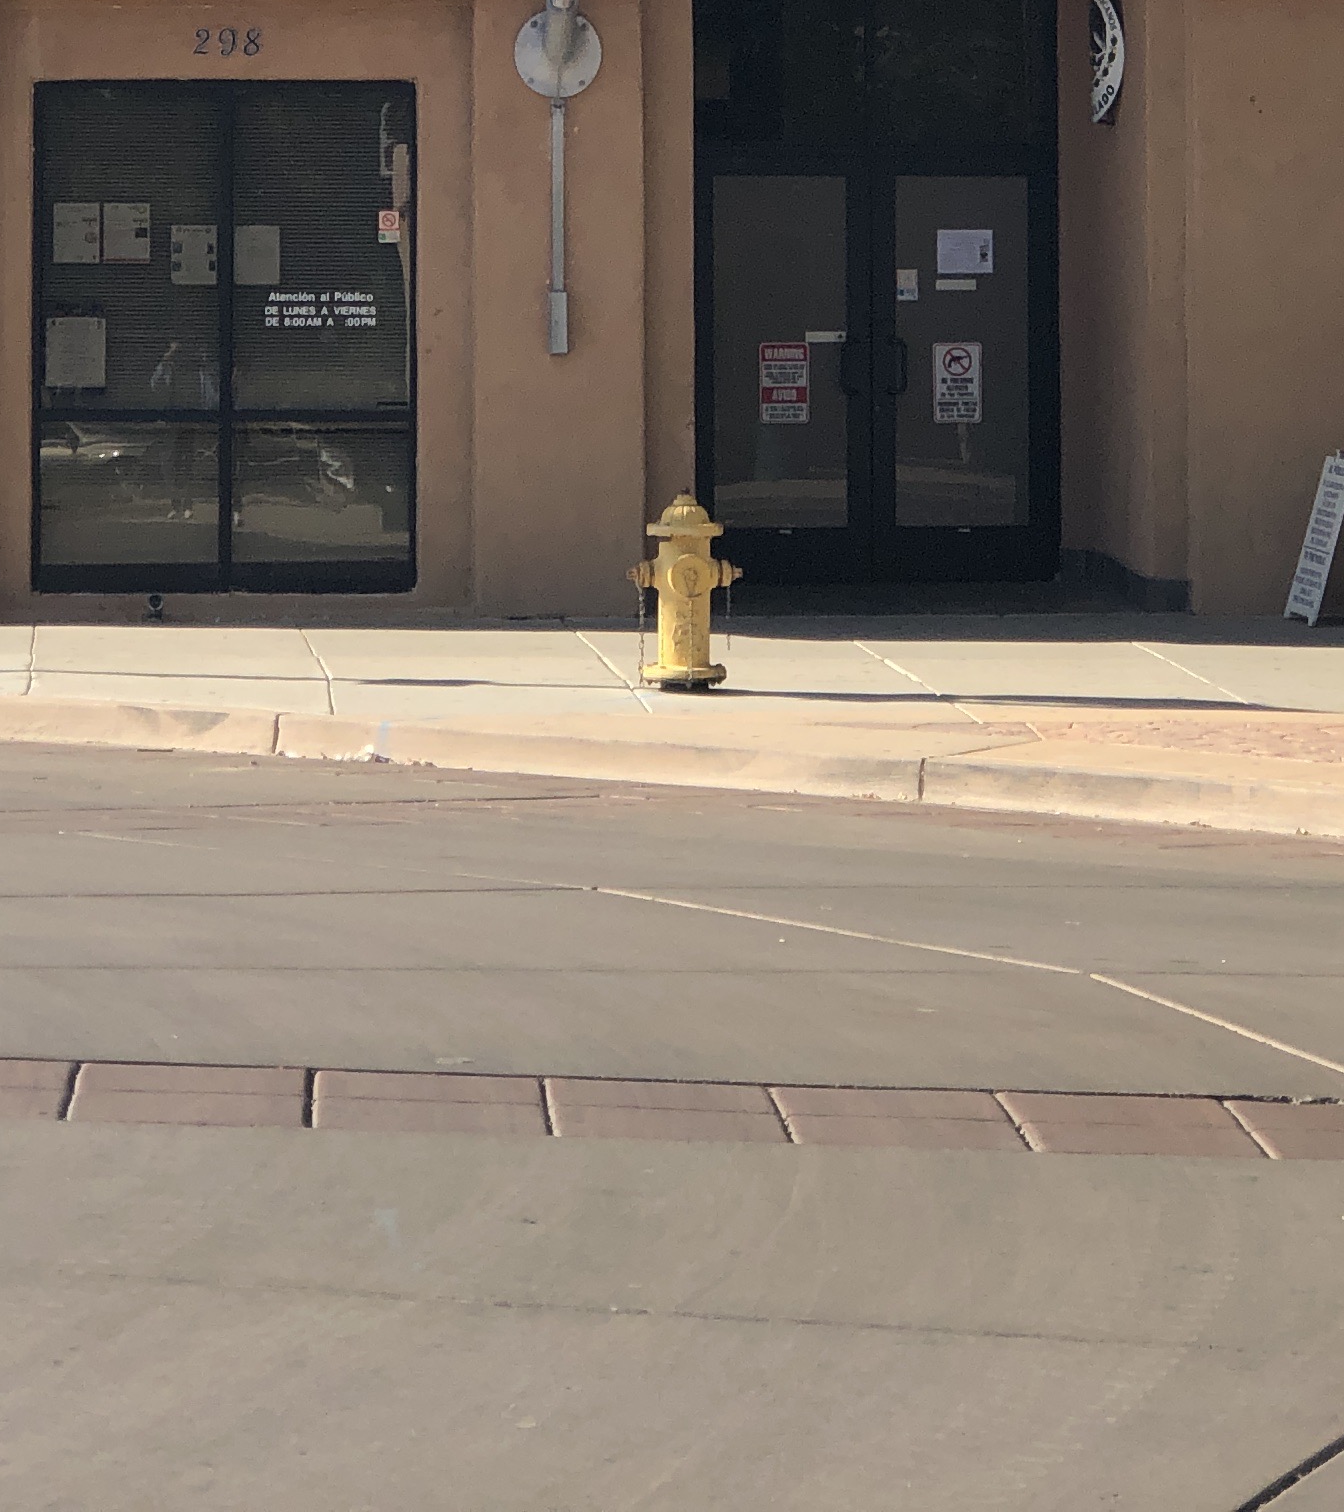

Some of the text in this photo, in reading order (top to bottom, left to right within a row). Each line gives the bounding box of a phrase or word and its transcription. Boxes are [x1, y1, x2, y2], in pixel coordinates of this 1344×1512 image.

[193, 28, 260, 56] 298
[268, 291, 374, 302] Atención al Público
[264, 306, 376, 316] DE LUNES A VIERNES
[265, 317, 280, 327] DE
[326, 317, 335, 327] A
